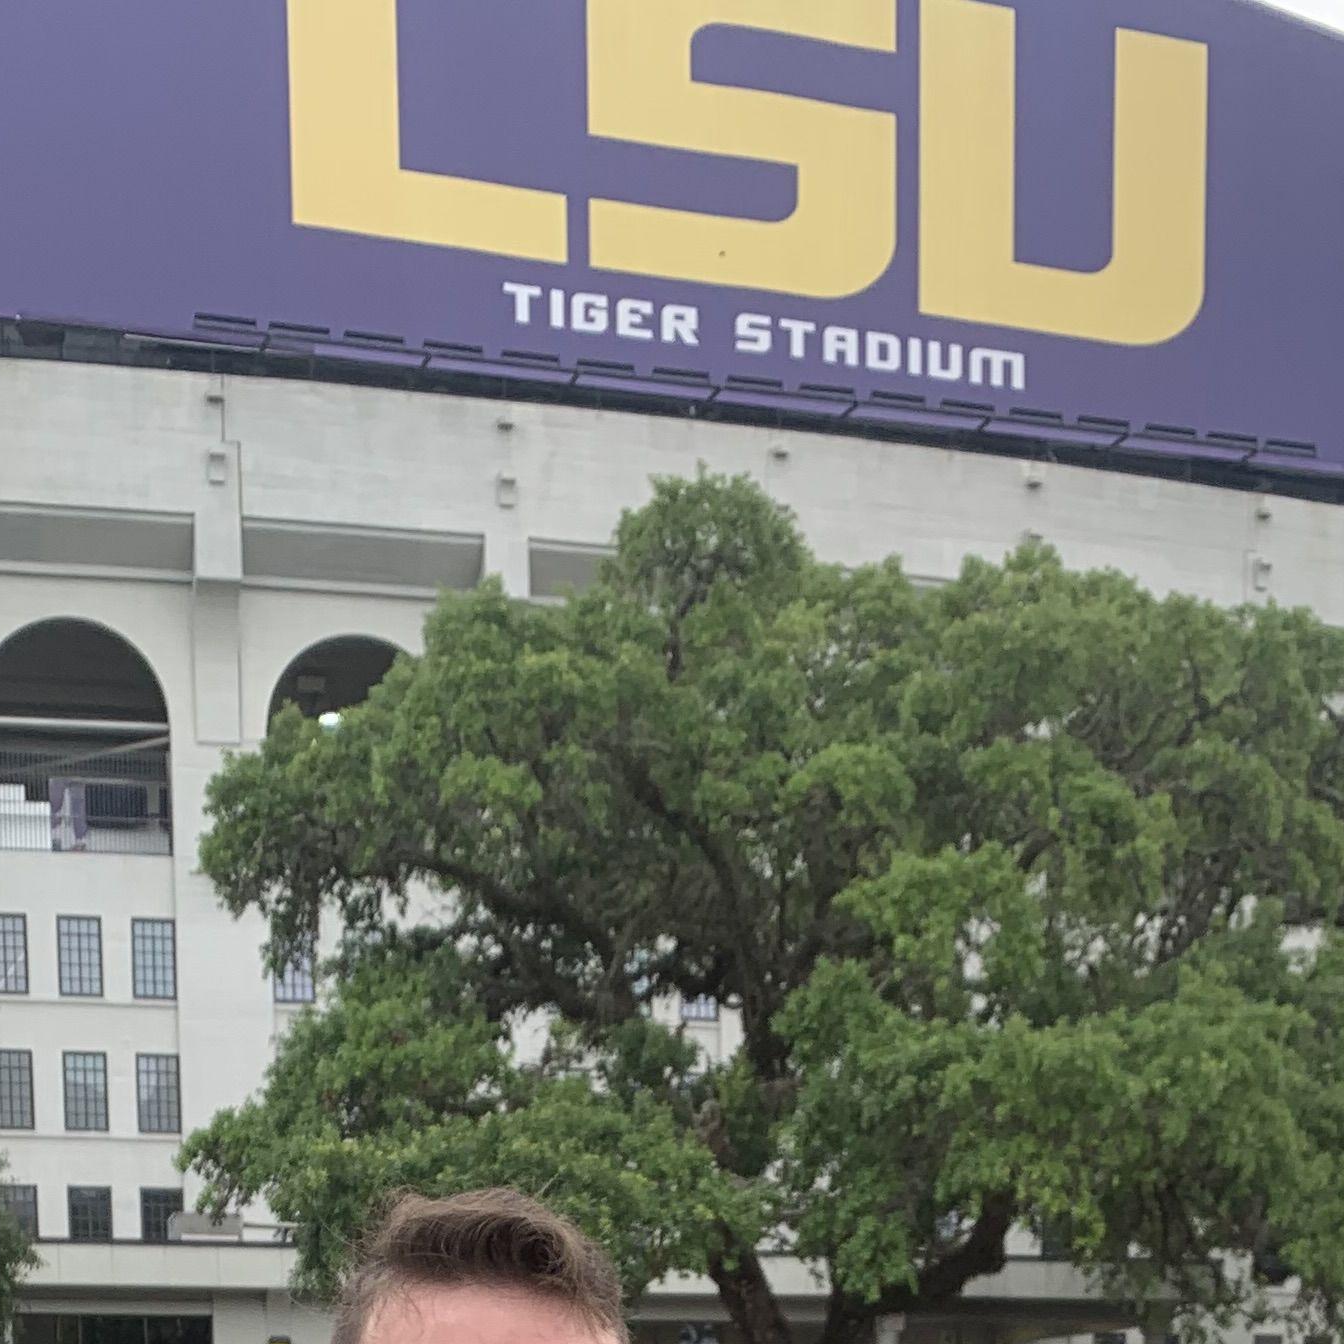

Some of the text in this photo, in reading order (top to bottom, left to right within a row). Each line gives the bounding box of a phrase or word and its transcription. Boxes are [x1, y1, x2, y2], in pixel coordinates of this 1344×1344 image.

[287, 0, 1207, 346] LSU
[502, 281, 1026, 390] TIGER STADIUM
